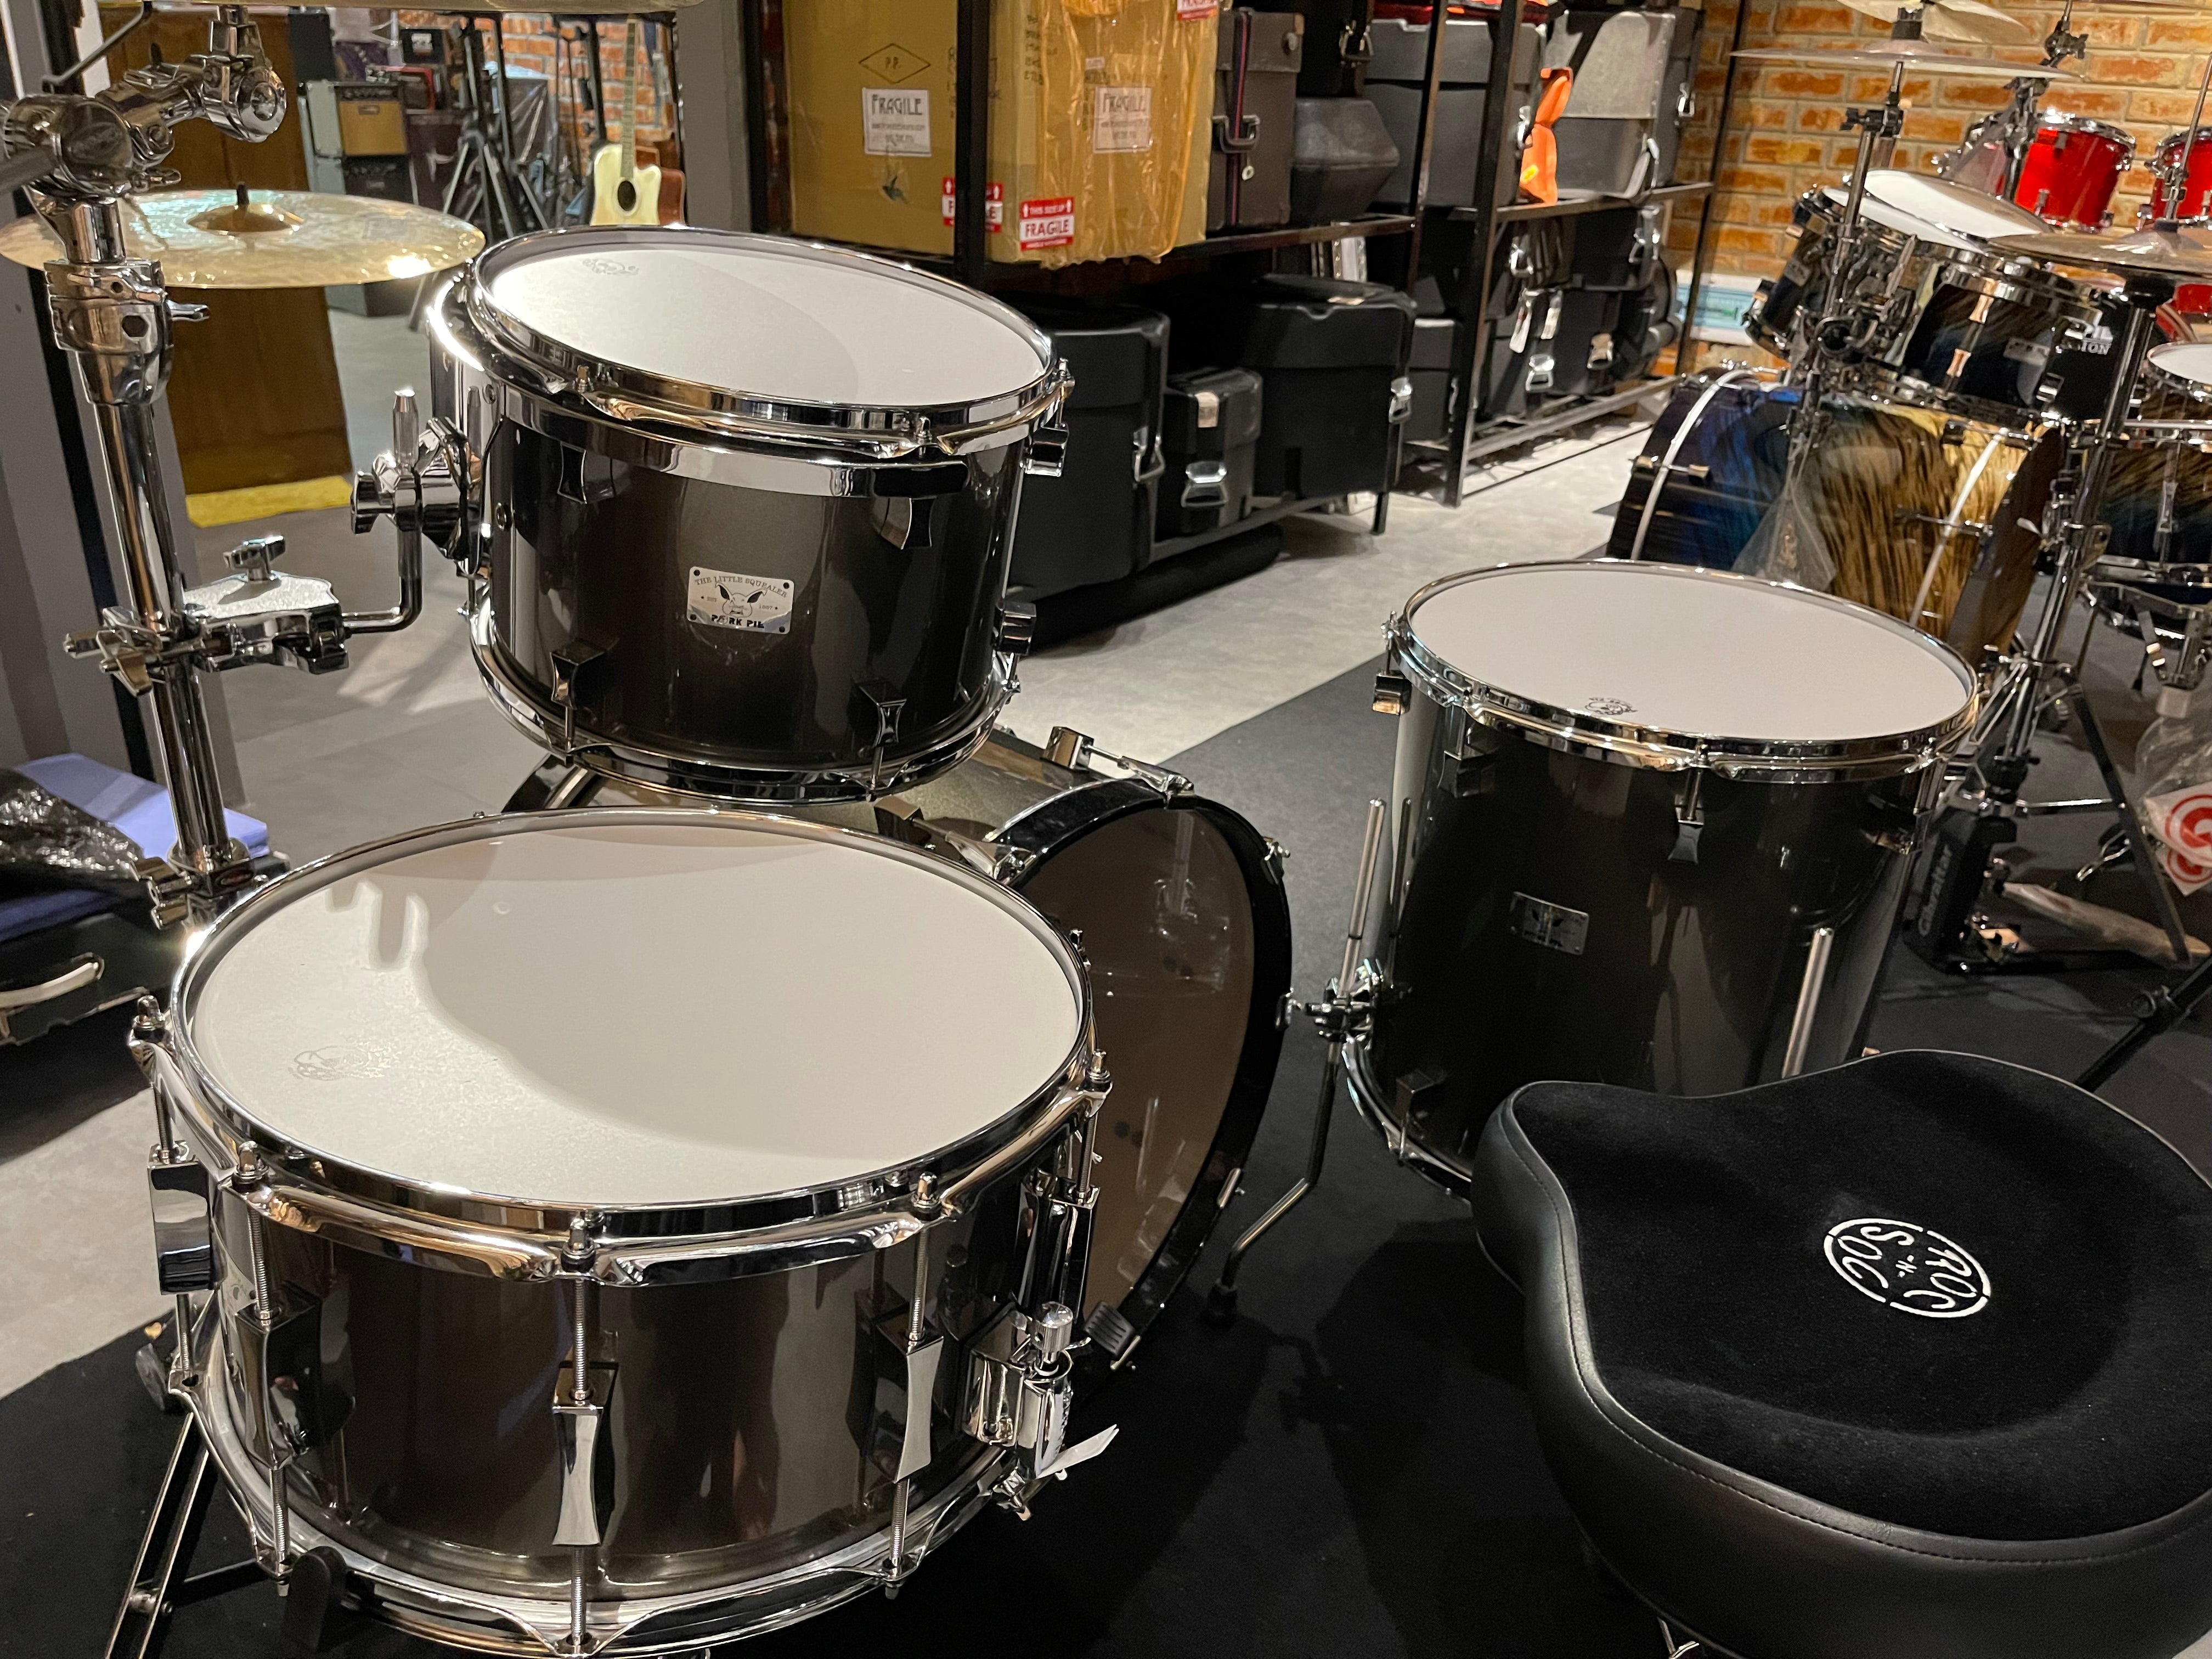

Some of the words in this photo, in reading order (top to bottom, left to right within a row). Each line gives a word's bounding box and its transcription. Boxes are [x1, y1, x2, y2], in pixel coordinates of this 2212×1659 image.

[871, 93, 923, 116] FRAGILE
[1103, 93, 1147, 112] FRAGILE
[1025, 219, 1069, 237] FRAGILE
[695, 577, 712, 585] THE
[714, 575, 743, 584] LITTLE
[745, 578, 788, 598] SQUEALER
[746, 620, 765, 629] PIE
